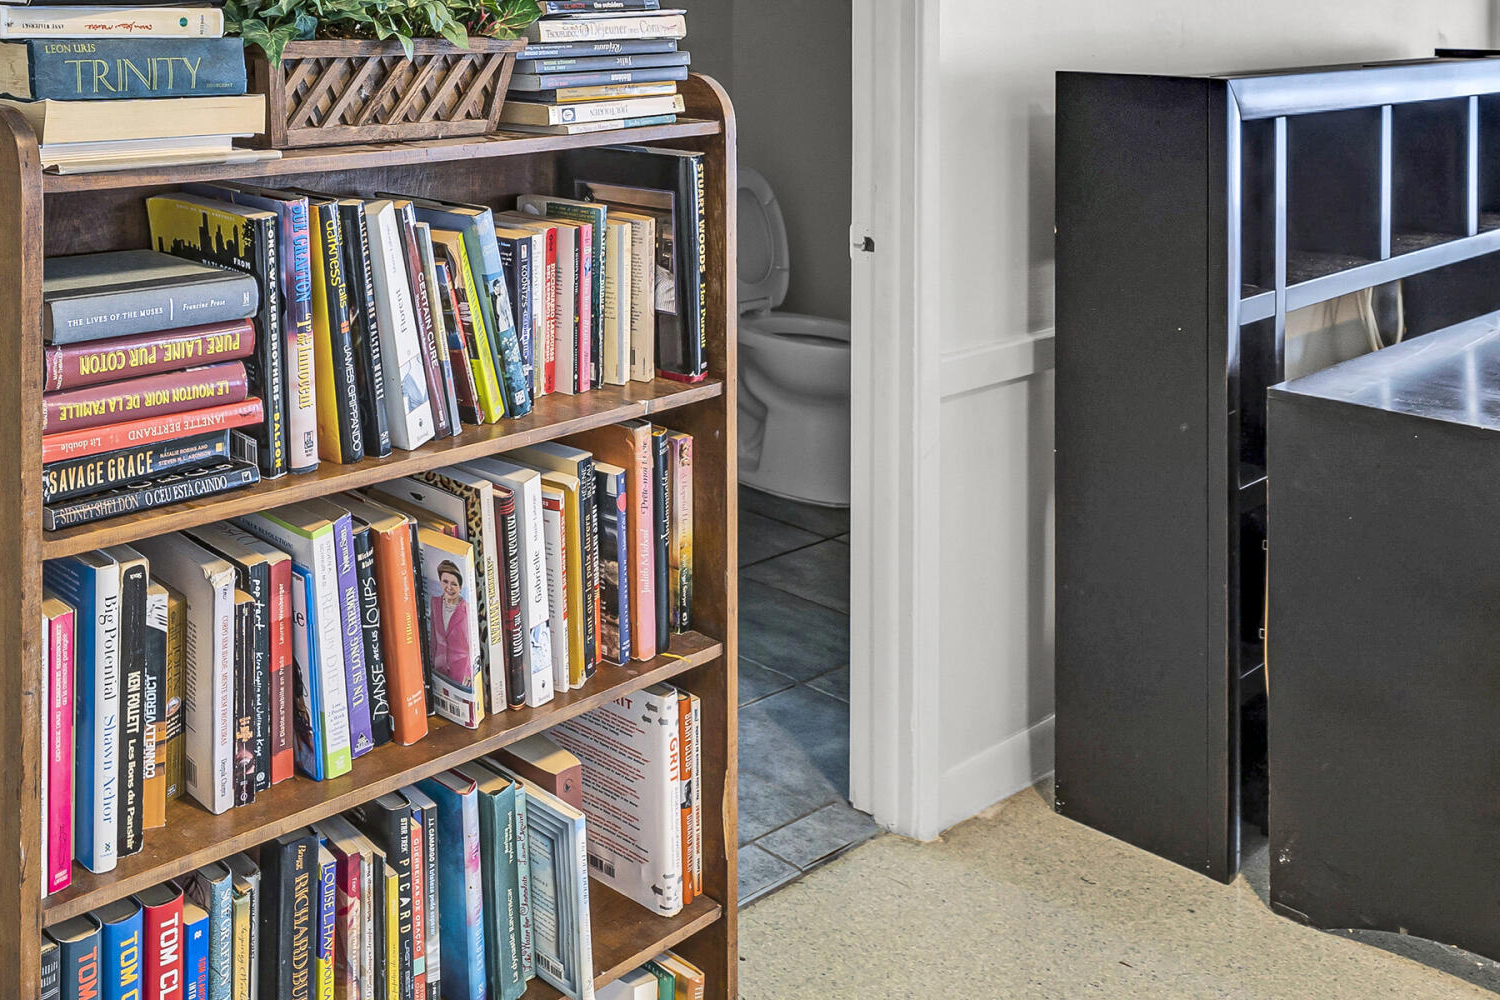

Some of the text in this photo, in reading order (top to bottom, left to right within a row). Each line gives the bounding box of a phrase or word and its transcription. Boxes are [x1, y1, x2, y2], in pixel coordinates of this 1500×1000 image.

[45, 43, 95, 54] LEON URIS
[64, 57, 201, 94] TRINITY
[292, 205, 308, 232] SUE
[293, 235, 311, 302] GRAFTON
[68, 299, 226, 328] THE LIVES OF THE MUSES Francine Prose
[396, 289, 408, 332] Florent
[418, 272, 431, 329] CERTAIN
[426, 332, 438, 368] CURE
[164, 340, 204, 361] LAINE,
[210, 334, 240, 353] PURE
[268, 230, 282, 468] ONCE WE WERE BROTHERS BALSON
[326, 220, 362, 451] darkness falls JAMES GRIPPANDO
[79, 354, 125, 374] COTON
[131, 350, 157, 367] PUR
[298, 346, 313, 408] Innocent
[109, 400, 122, 413] LA
[124, 396, 140, 410] DE
[146, 393, 169, 409] NOIR
[172, 385, 214, 403] MOUTON
[215, 381, 229, 396] LE
[60, 403, 105, 421] FAMILLE
[61, 414, 225, 450] JANETTE BERTRAND Lit double
[50, 451, 153, 494] SAVAGE GRACE
[96, 493, 139, 519] SHELDON
[145, 492, 153, 505] O
[154, 485, 169, 503] CÉU
[195, 476, 227, 495] CAINDO
[532, 550, 543, 603] Gabrielle
[585, 554, 593, 578] paix
[585, 580, 592, 591] la
[253, 579, 265, 630] pop tart
[345, 586, 359, 635] CHEMIN
[363, 577, 380, 628] LOUPS
[405, 612, 413, 644] Willow
[349, 639, 361, 669] LONG
[279, 677, 285, 685] en
[351, 671, 362, 684] SI
[352, 685, 365, 705] UN
[371, 663, 389, 720] DANSE
[99, 595, 117, 823] Big Potential Shawn Achor
[145, 675, 157, 778] CONNELLY VERDICT
[126, 671, 140, 849] KEN FOLLETT Les lions du Panshir
[669, 737, 678, 783] GRIT
[400, 818, 408, 835] STAR
[399, 859, 411, 934] PICARD
[414, 904, 421, 912] DE
[160, 912, 179, 966] TOM
[220, 888, 231, 986] SUE GRAFTON
[292, 872, 309, 969] RICHARD
[323, 864, 335, 985] LOUISE L. HAY YOU
[507, 888, 519, 982] La dynastie Ravenscar
[78, 947, 97, 1000] TOM
[120, 931, 138, 984] TOM
[198, 956, 206, 973] TOM
